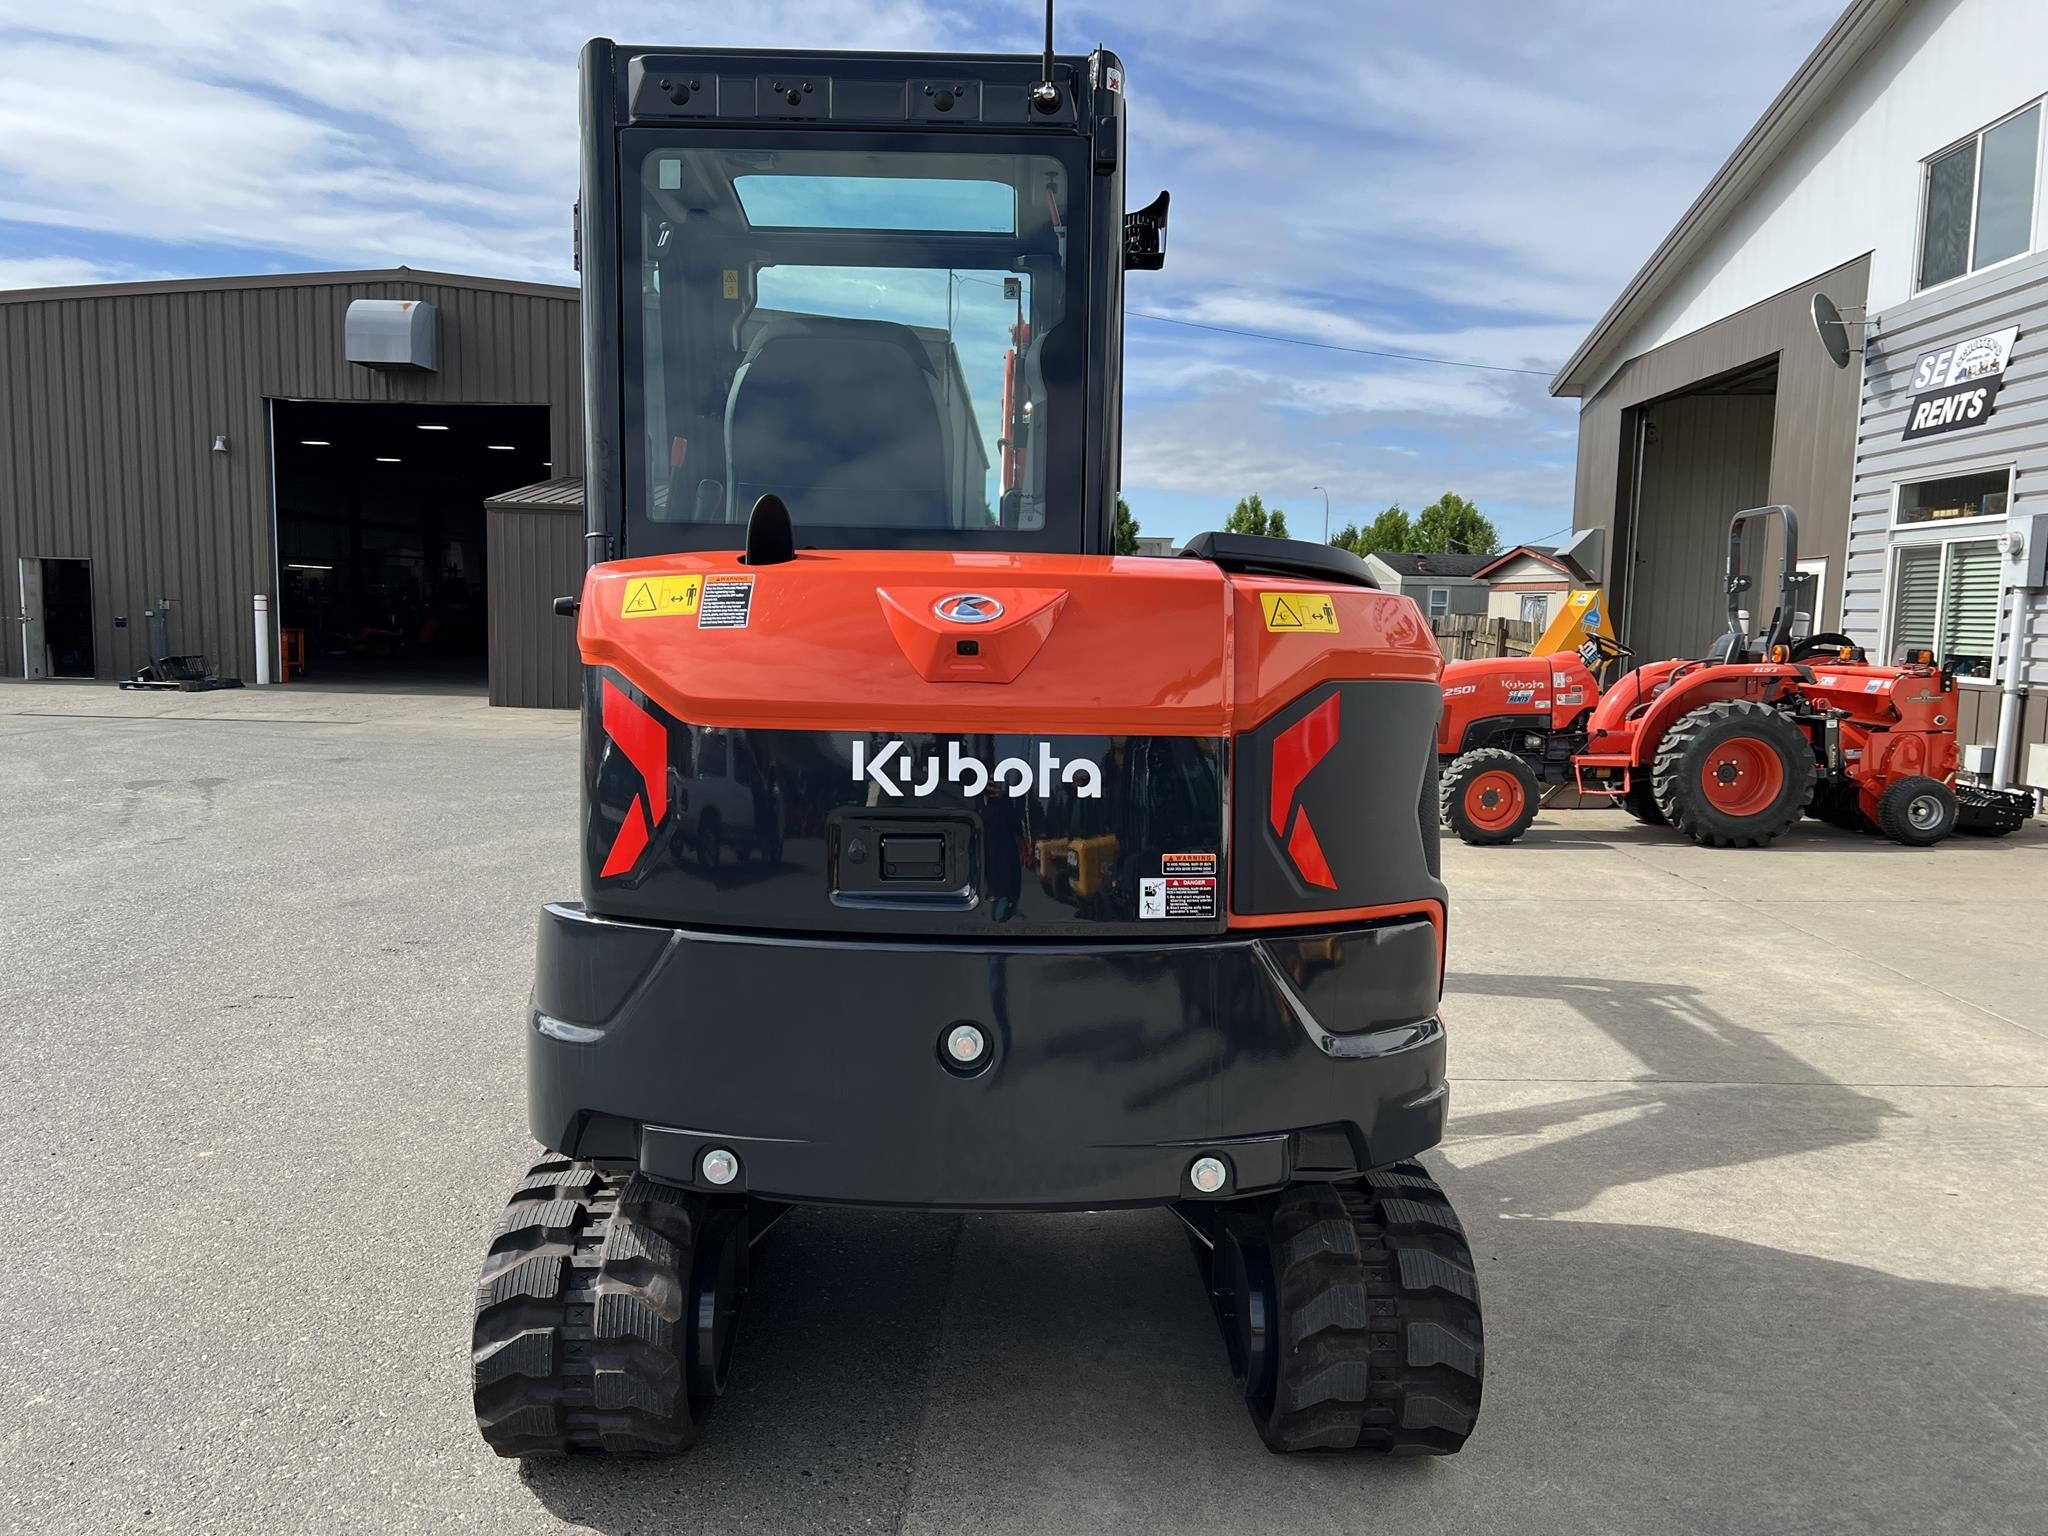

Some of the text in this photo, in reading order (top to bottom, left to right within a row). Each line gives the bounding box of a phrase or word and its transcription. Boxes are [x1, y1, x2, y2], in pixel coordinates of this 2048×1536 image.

[1914, 350, 1953, 389] SE
[1911, 388, 1988, 431] RENTS
[1501, 680, 1545, 690] Kubota
[852, 740, 1102, 798] Kubota
